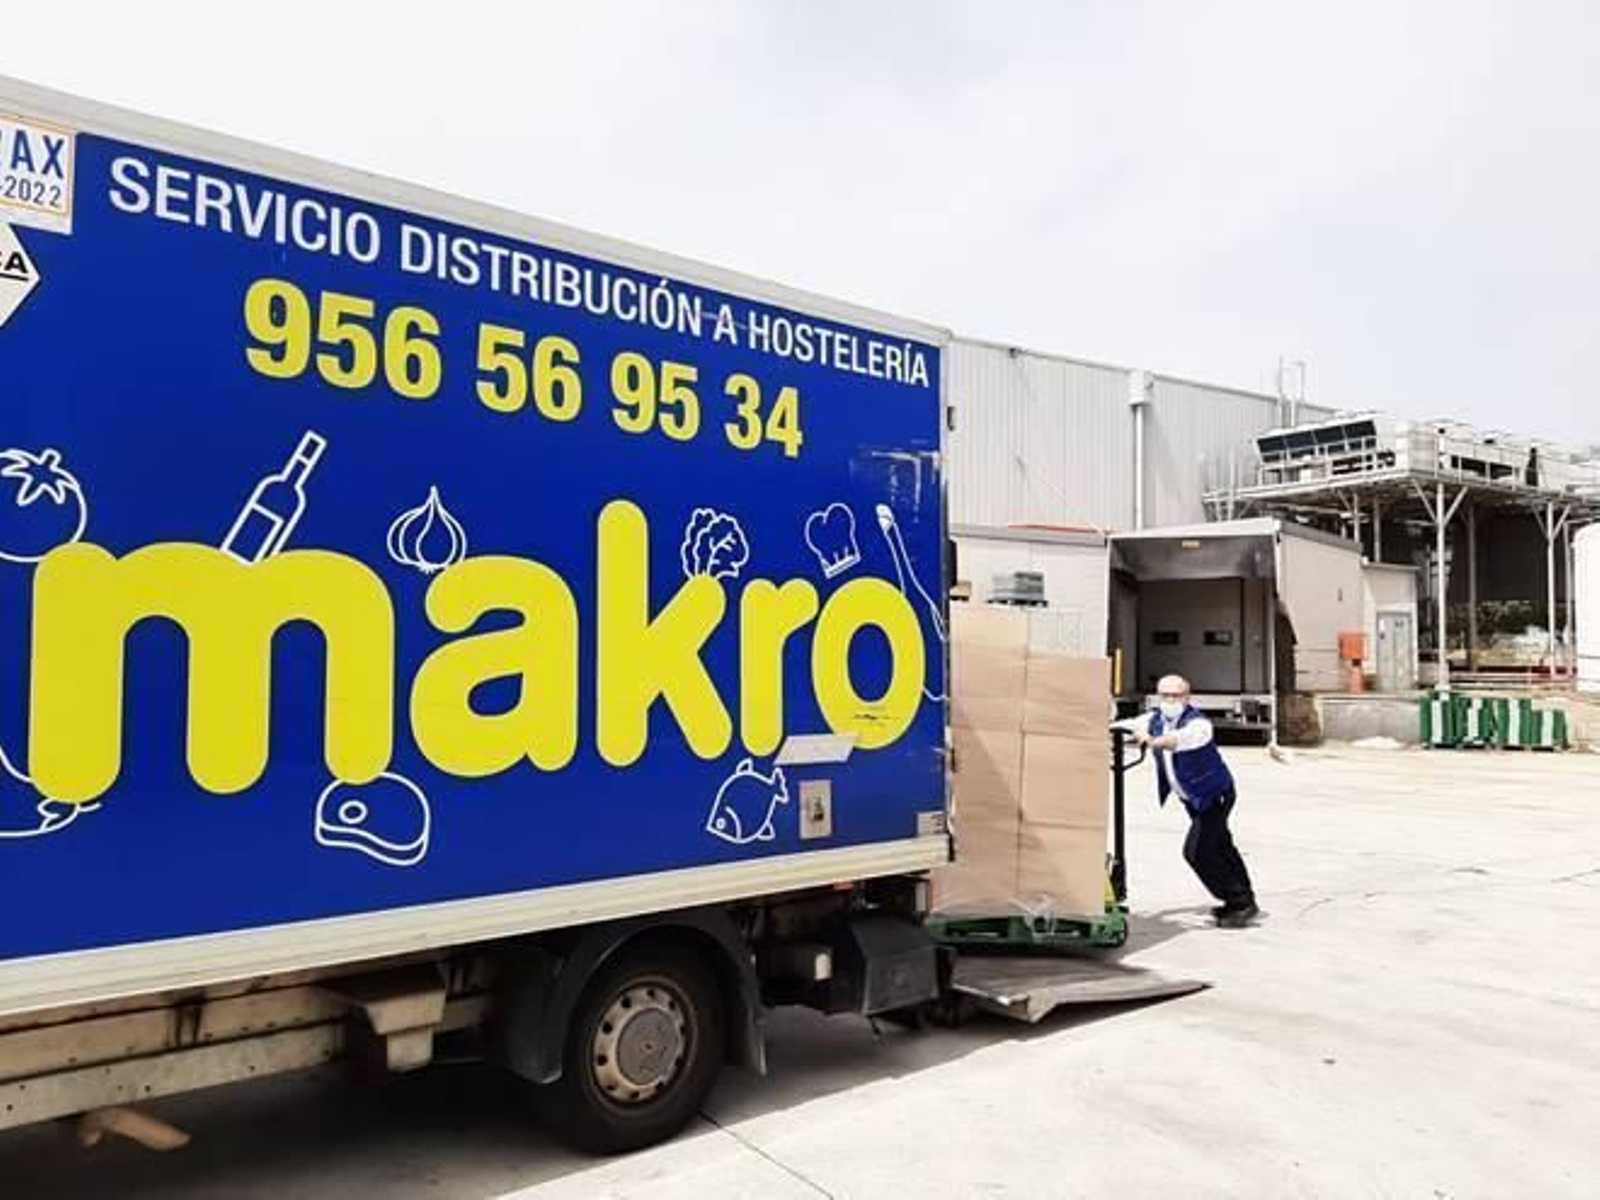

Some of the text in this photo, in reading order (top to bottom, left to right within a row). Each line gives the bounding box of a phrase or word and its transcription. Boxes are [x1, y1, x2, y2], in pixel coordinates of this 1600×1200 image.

[0, 129, 65, 179] AX
[109, 156, 930, 388] SERVICIO DISTRIBUCIÓN A HOSTELERÍA
[245, 280, 804, 458] 956 56 95 34
[29, 499, 927, 806] makro
